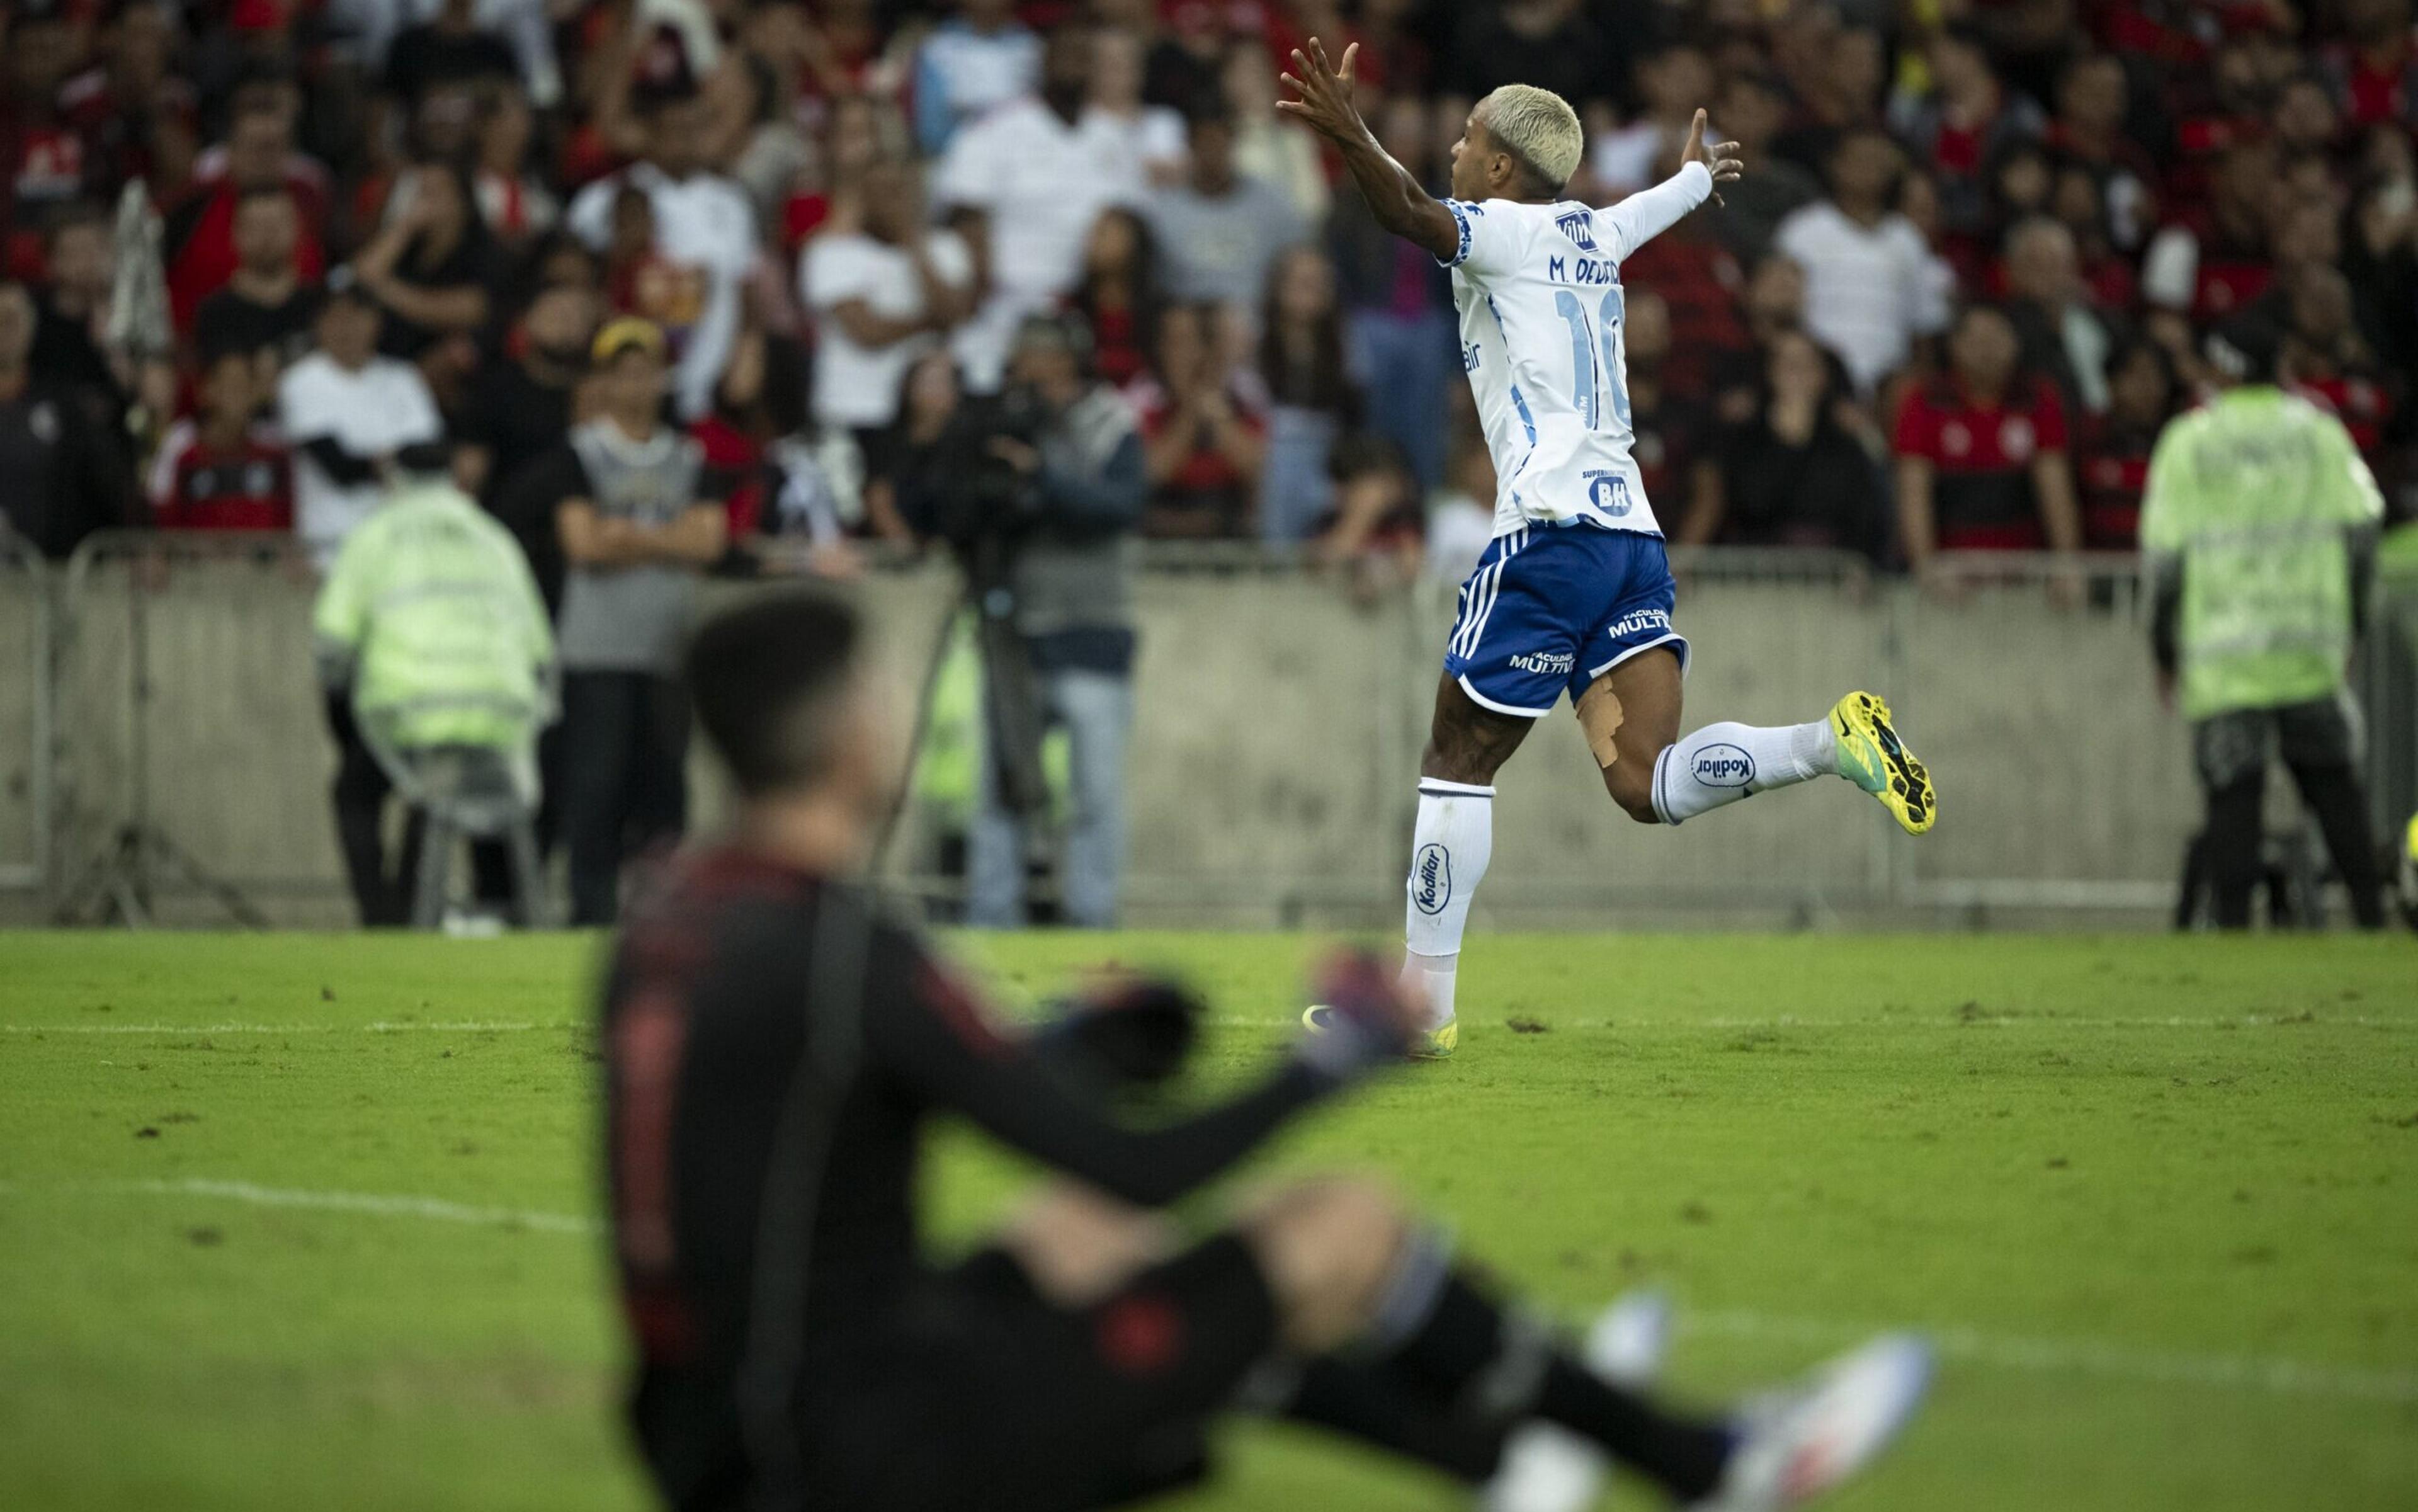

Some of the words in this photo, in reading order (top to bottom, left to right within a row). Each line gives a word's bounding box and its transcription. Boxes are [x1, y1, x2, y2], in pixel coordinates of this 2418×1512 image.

[1550, 254, 1569, 283] M.
[1555, 288, 1632, 431] 10
[1598, 482, 1628, 508] BH
[1696, 759, 1750, 778] Kodilar
[1419, 849, 1440, 908] Kodilar
